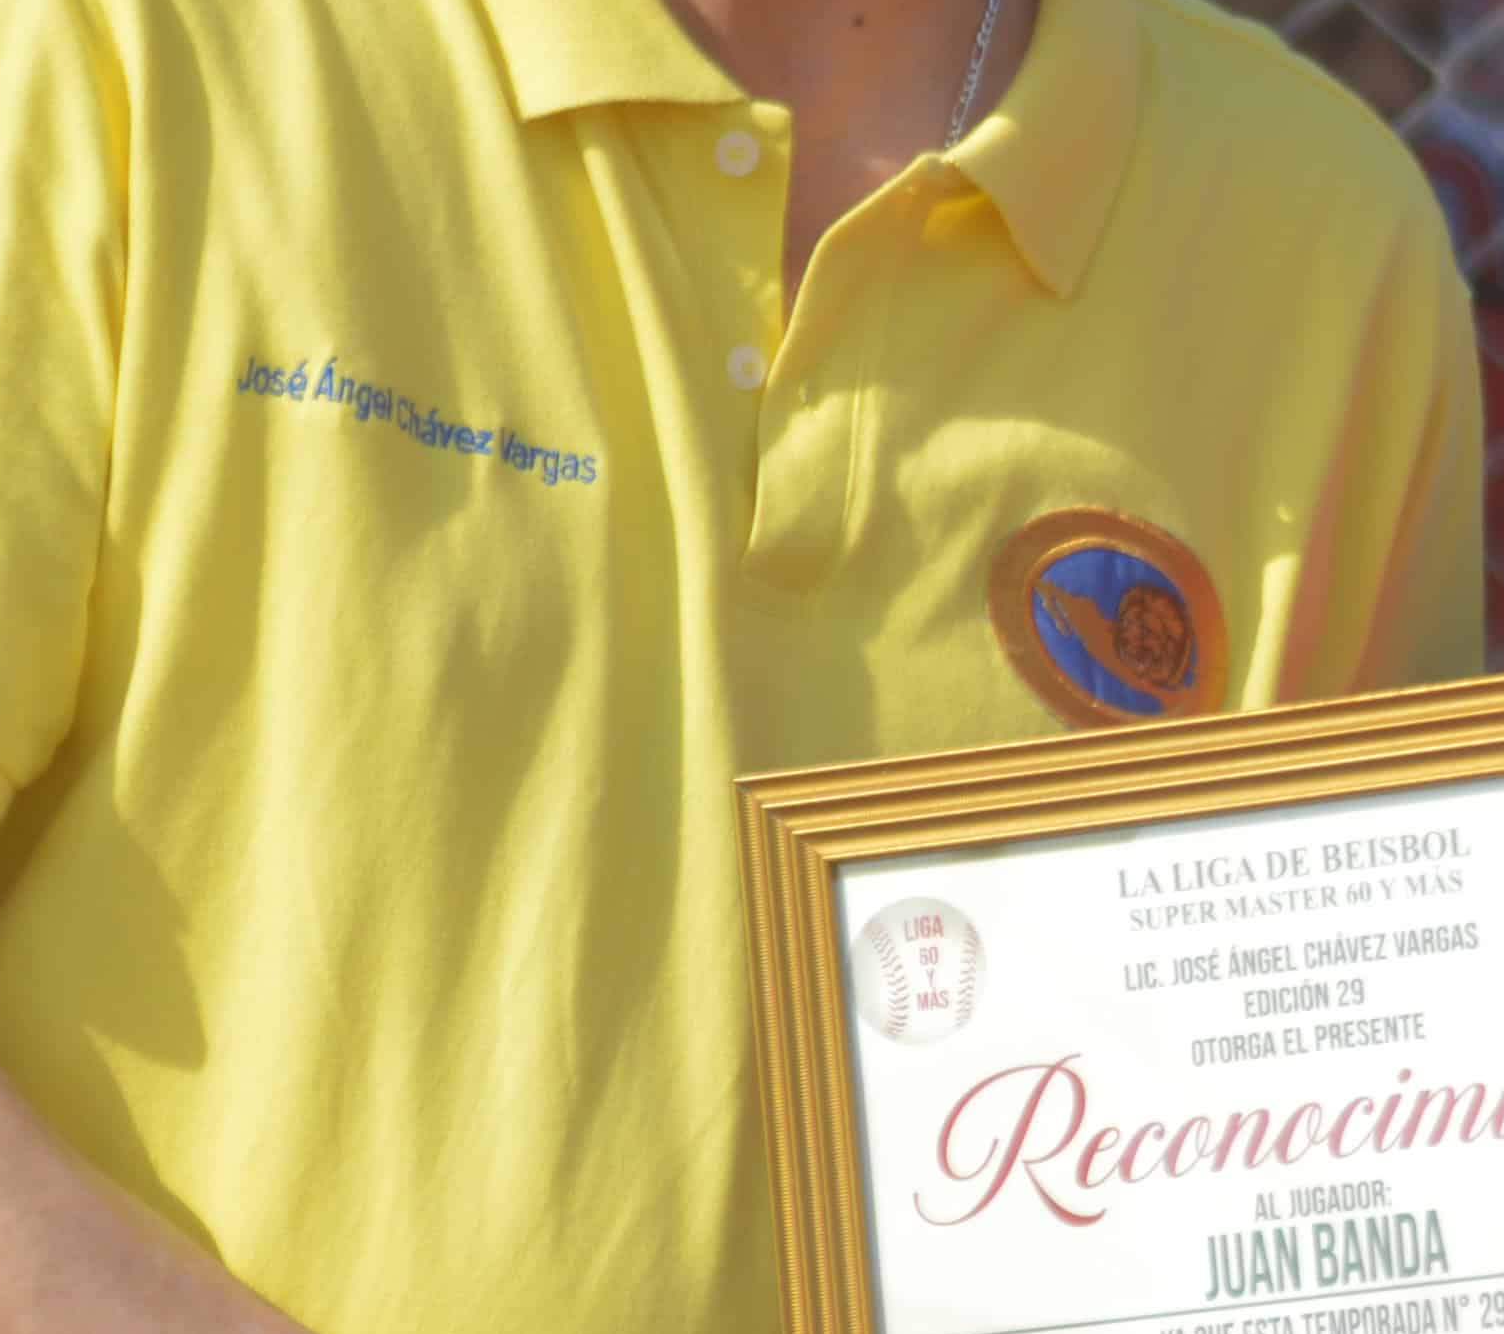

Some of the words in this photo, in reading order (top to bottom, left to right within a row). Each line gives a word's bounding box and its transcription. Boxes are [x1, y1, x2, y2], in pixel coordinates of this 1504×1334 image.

[237, 356, 308, 401] José
[314, 356, 392, 422] Ángel
[396, 397, 494, 457] Chávez
[498, 426, 597, 486] Vargas
[1117, 867, 1163, 898] LA
[1172, 857, 1256, 892] LIGA
[1265, 847, 1311, 880] DE
[1322, 828, 1471, 875] BEISBOL
[904, 914, 944, 942] LIGA
[1129, 901, 1216, 932] SUPER
[1225, 886, 1338, 920] MASTER
[1346, 883, 1372, 906] 60
[1379, 879, 1396, 902] Y
[1405, 865, 1464, 898] MÁS
[926, 968, 935, 988] Y
[1124, 961, 1164, 992] LIC.
[1171, 948, 1221, 986] JOSÉ
[1227, 944, 1296, 979] ÁNGEL
[1304, 931, 1386, 969] CHÁVEZ
[1393, 922, 1479, 958] VARGAS
[1243, 975, 1330, 1018] EDICIÓN
[1337, 978, 1365, 1008] 29
[1191, 1033, 1277, 1067] OTORGA
[1283, 1027, 1309, 1055] EL
[1315, 1013, 1426, 1052] PRESENTE
[1255, 1192, 1281, 1221] AL
[1288, 1179, 1392, 1218] JUGADOR:
[1205, 1225, 1302, 1301] JUAN
[1312, 1209, 1449, 1287] BANDA
